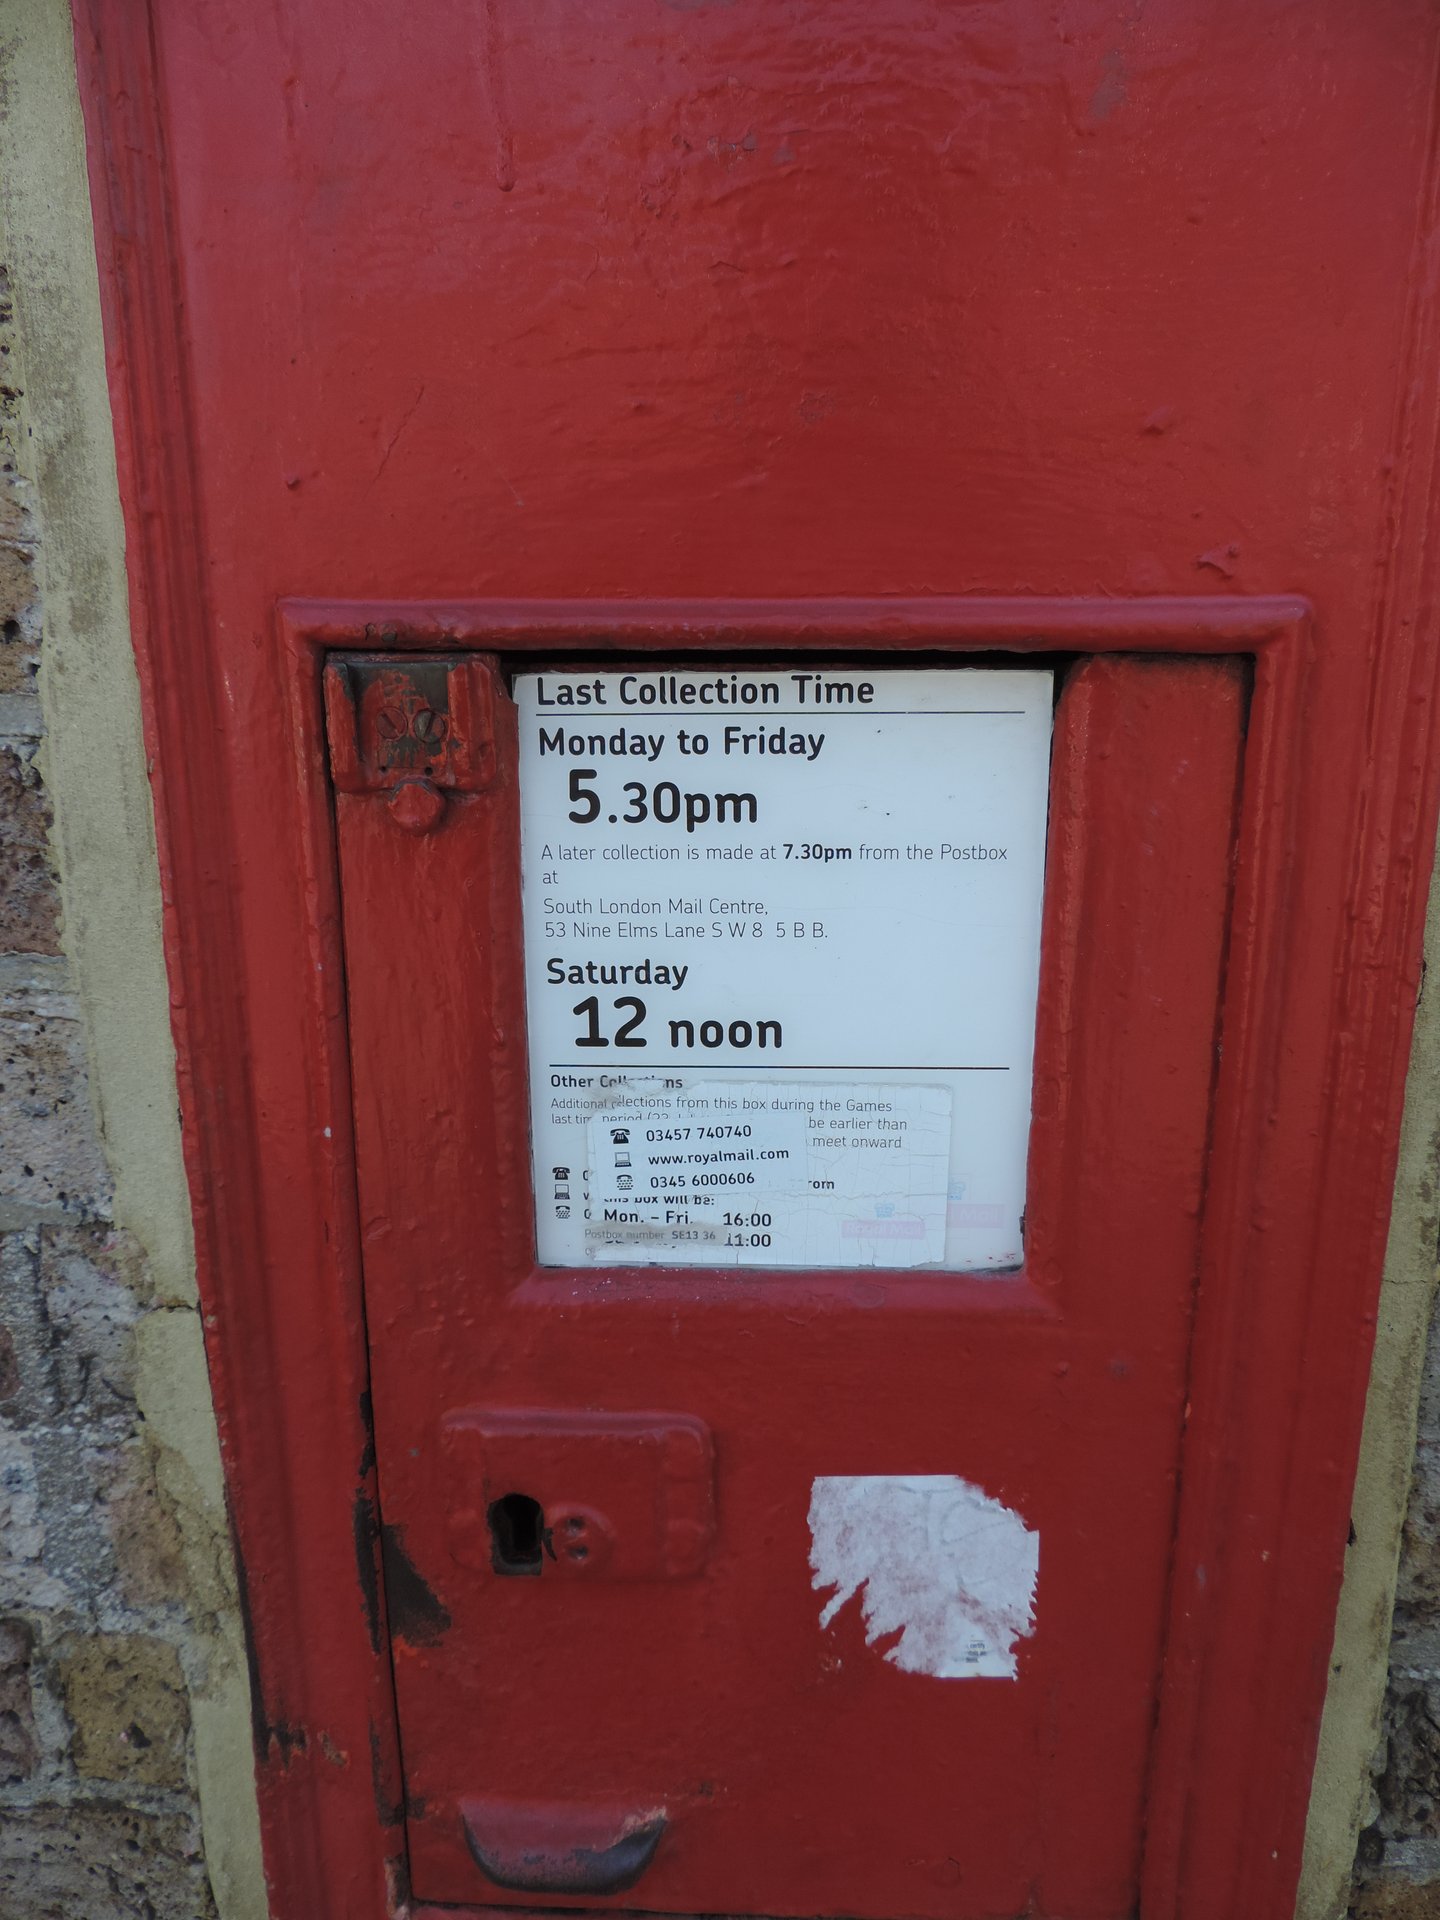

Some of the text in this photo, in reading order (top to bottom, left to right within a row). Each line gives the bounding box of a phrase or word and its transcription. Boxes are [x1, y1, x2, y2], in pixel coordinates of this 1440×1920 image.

[538, 675, 874, 705] Last Collection Time
[539, 726, 825, 761] Monday to Friday
[569, 769, 757, 833] 5.30pm
[542, 844, 1007, 863] A later collection is made at 7.30pm from the Postbox
[543, 871, 558, 884] at
[544, 898, 767, 915] South London Mail Centre,
[546, 922, 565, 937] 53
[574, 922, 610, 937] Nine
[619, 922, 657, 937] Elms
[665, 922, 704, 937] Lane
[547, 958, 688, 990] Saturday
[573, 996, 782, 1048] 12 noon
[551, 1075, 594, 1087] Other
[551, 1098, 608, 1109] Additional
[677, 1096, 708, 1108] from
[714, 1097, 737, 1109] this
[743, 1098, 766, 1109] box
[772, 1098, 814, 1113] during
[820, 1099, 840, 1111] the
[847, 1099, 892, 1111] Games
[552, 1114, 572, 1124] last
[576, 1114, 592, 1124] tim
[809, 1116, 824, 1128] be
[830, 1118, 872, 1129] earlier
[878, 1118, 907, 1130] than
[647, 1125, 751, 1141] 03457 740740
[813, 1136, 901, 1148] meet onward
[648, 1149, 789, 1165] www.royalmail.com
[651, 1172, 754, 1188] 0345 6000606
[605, 1209, 644, 1223] Mon.
[666, 1211, 693, 1224] Fri.
[723, 1213, 771, 1226] 16:00
[585, 1228, 622, 1240] Postbox
[626, 1229, 665, 1240] number
[672, 1230, 698, 1239] SE13
[725, 1233, 771, 1247] 11:00
